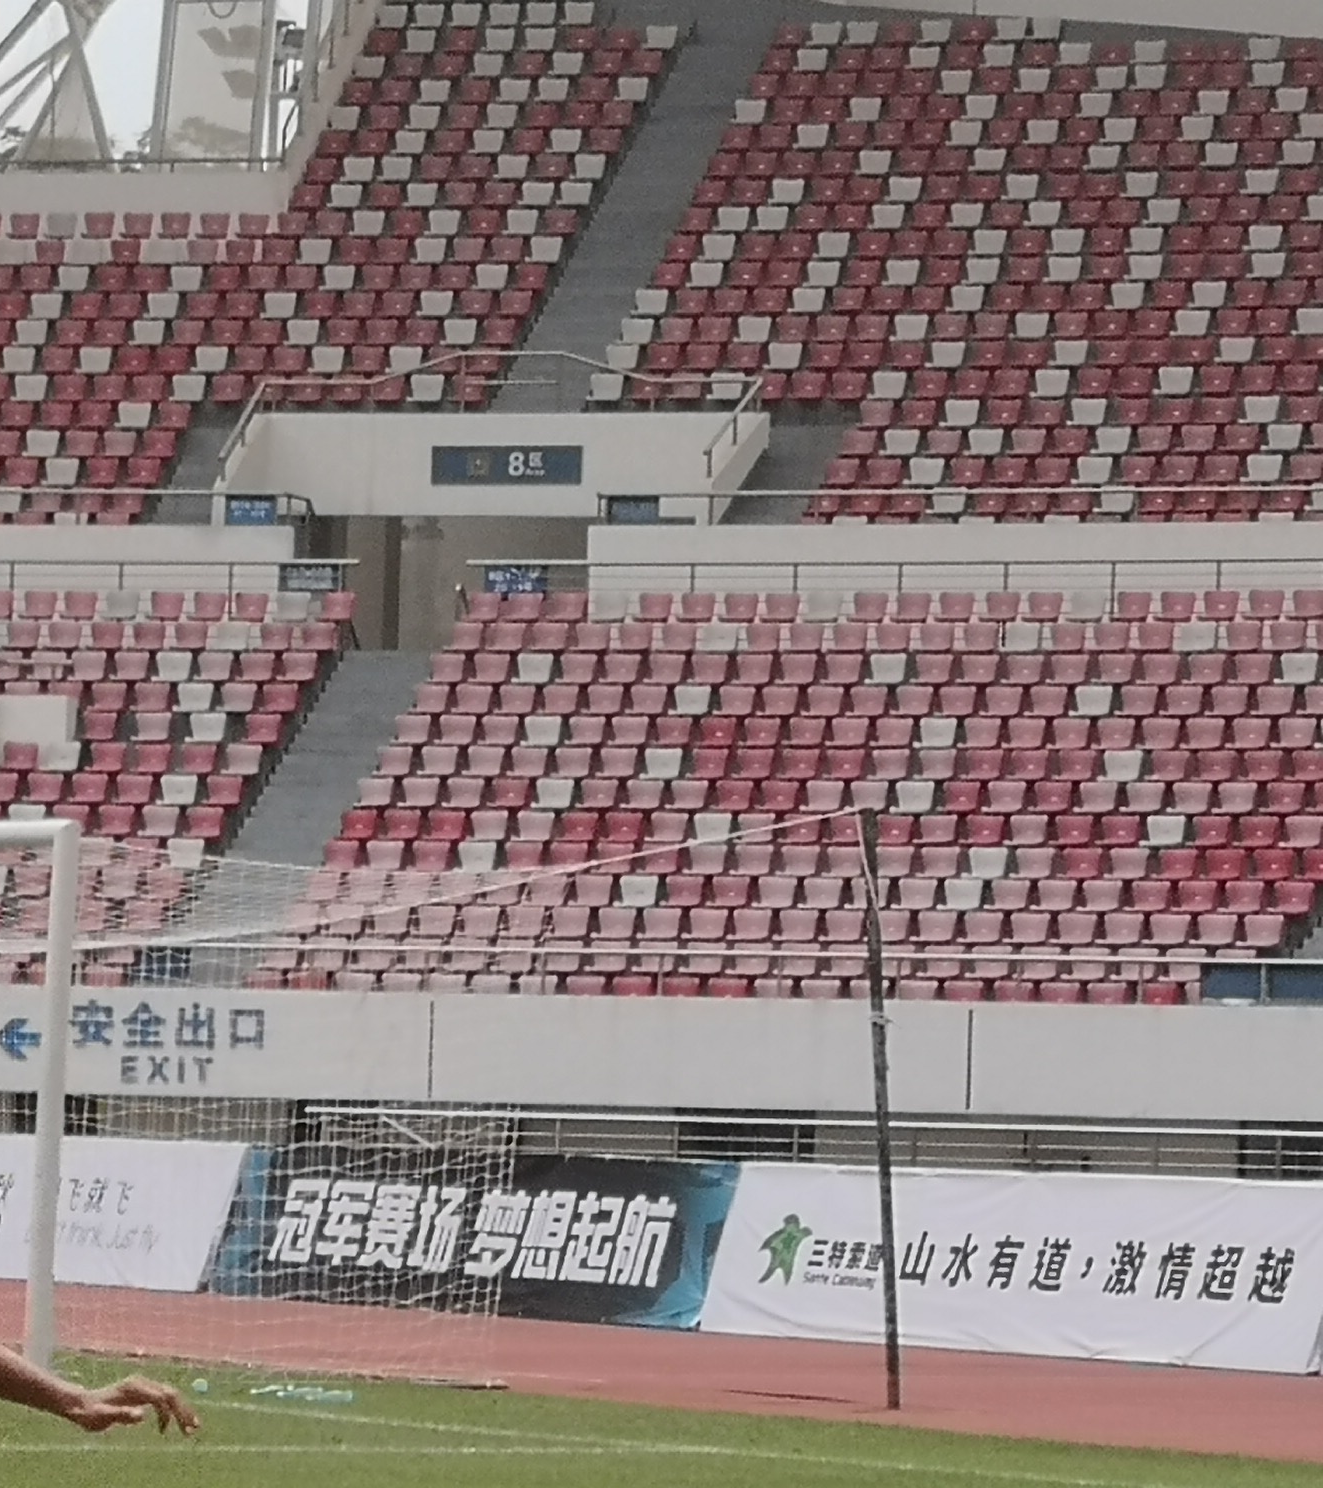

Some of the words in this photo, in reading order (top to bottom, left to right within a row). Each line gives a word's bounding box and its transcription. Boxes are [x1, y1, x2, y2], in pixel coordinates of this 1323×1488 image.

[68, 999, 265, 1050] 安全出口
[120, 1056, 214, 1085] EXIT
[269, 1179, 467, 1271] 冠军赛场
[465, 1189, 677, 1288] 梦想起航
